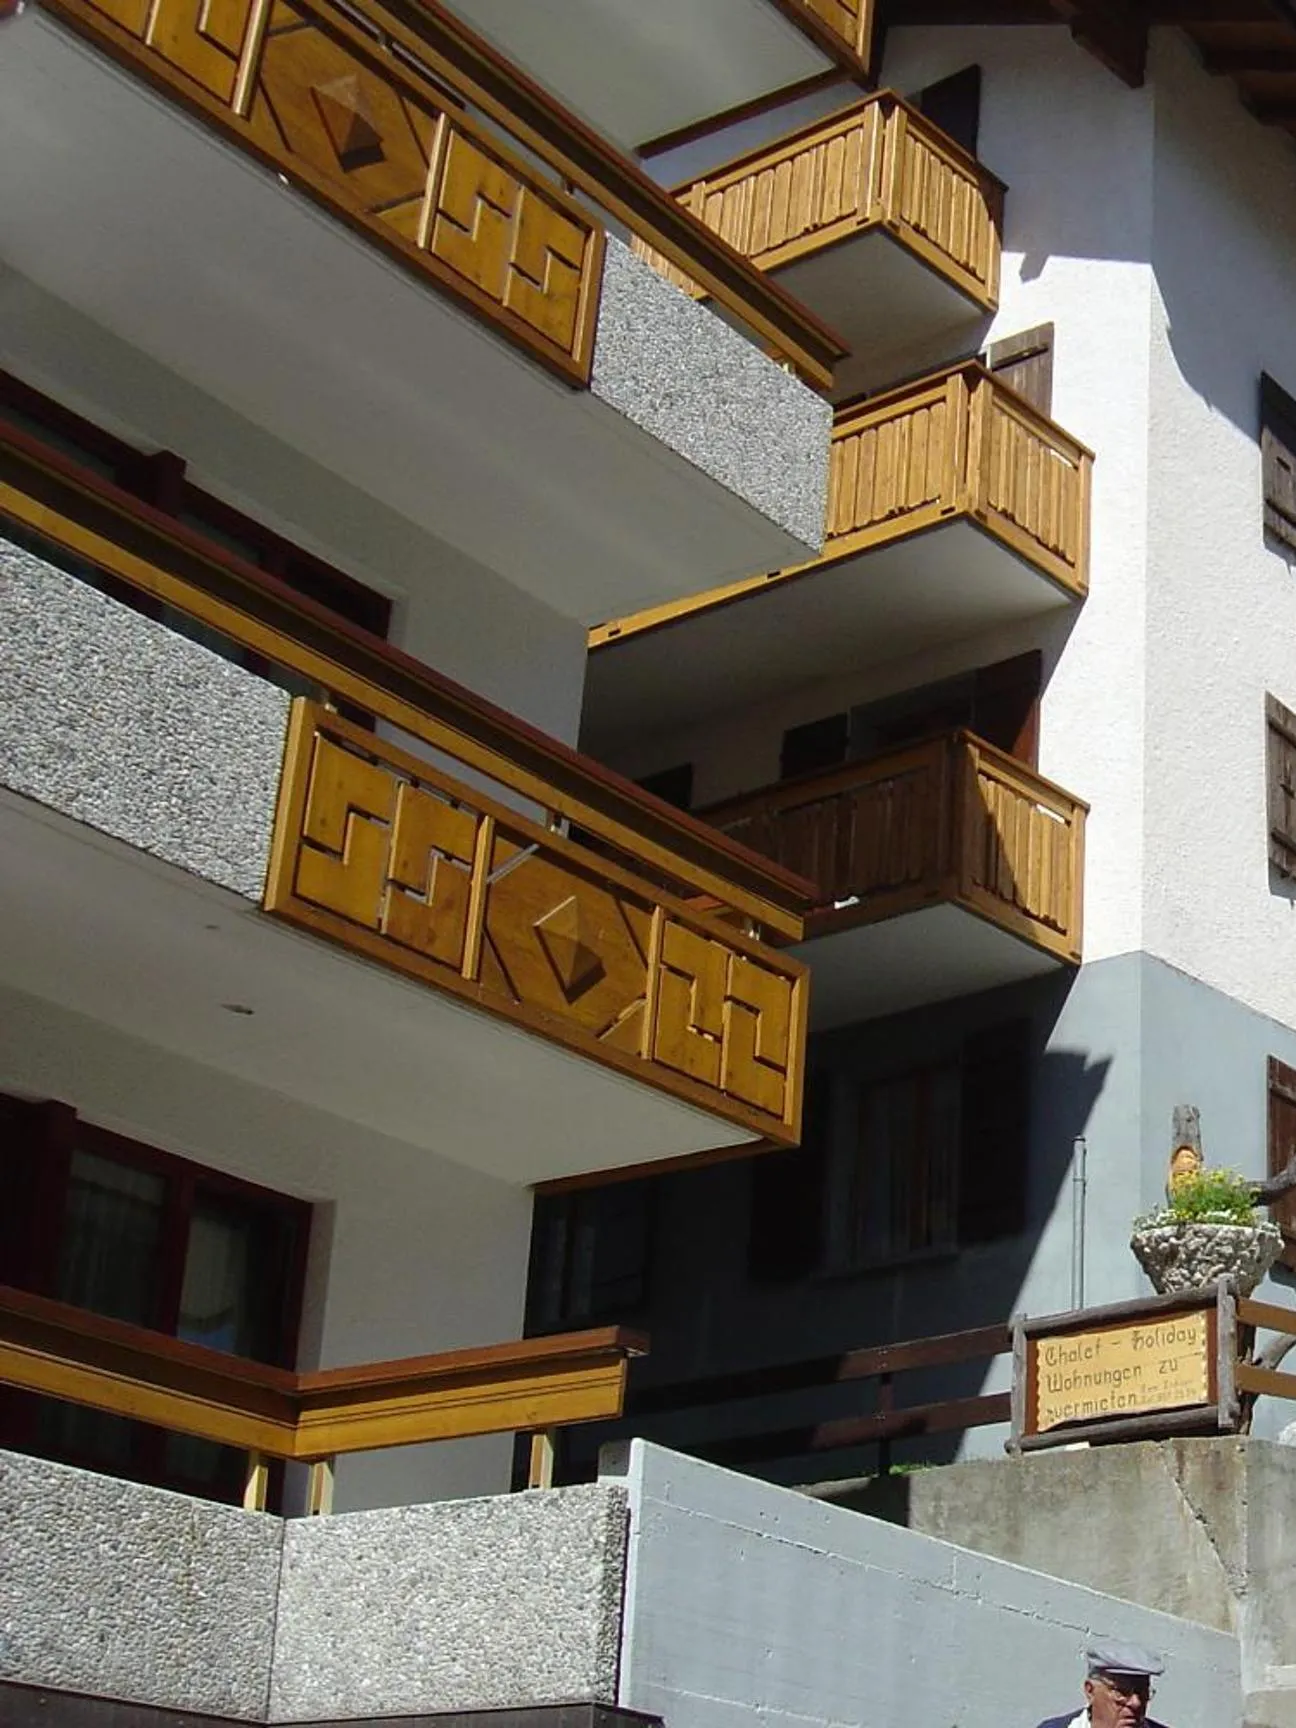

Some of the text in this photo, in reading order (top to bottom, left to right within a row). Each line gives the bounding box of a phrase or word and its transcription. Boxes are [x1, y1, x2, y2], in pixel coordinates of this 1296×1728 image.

[1044, 1336, 1101, 1367] Chalet
[1046, 1363, 1142, 1394] Wohnungen
[1158, 1358, 1179, 1375] zu
